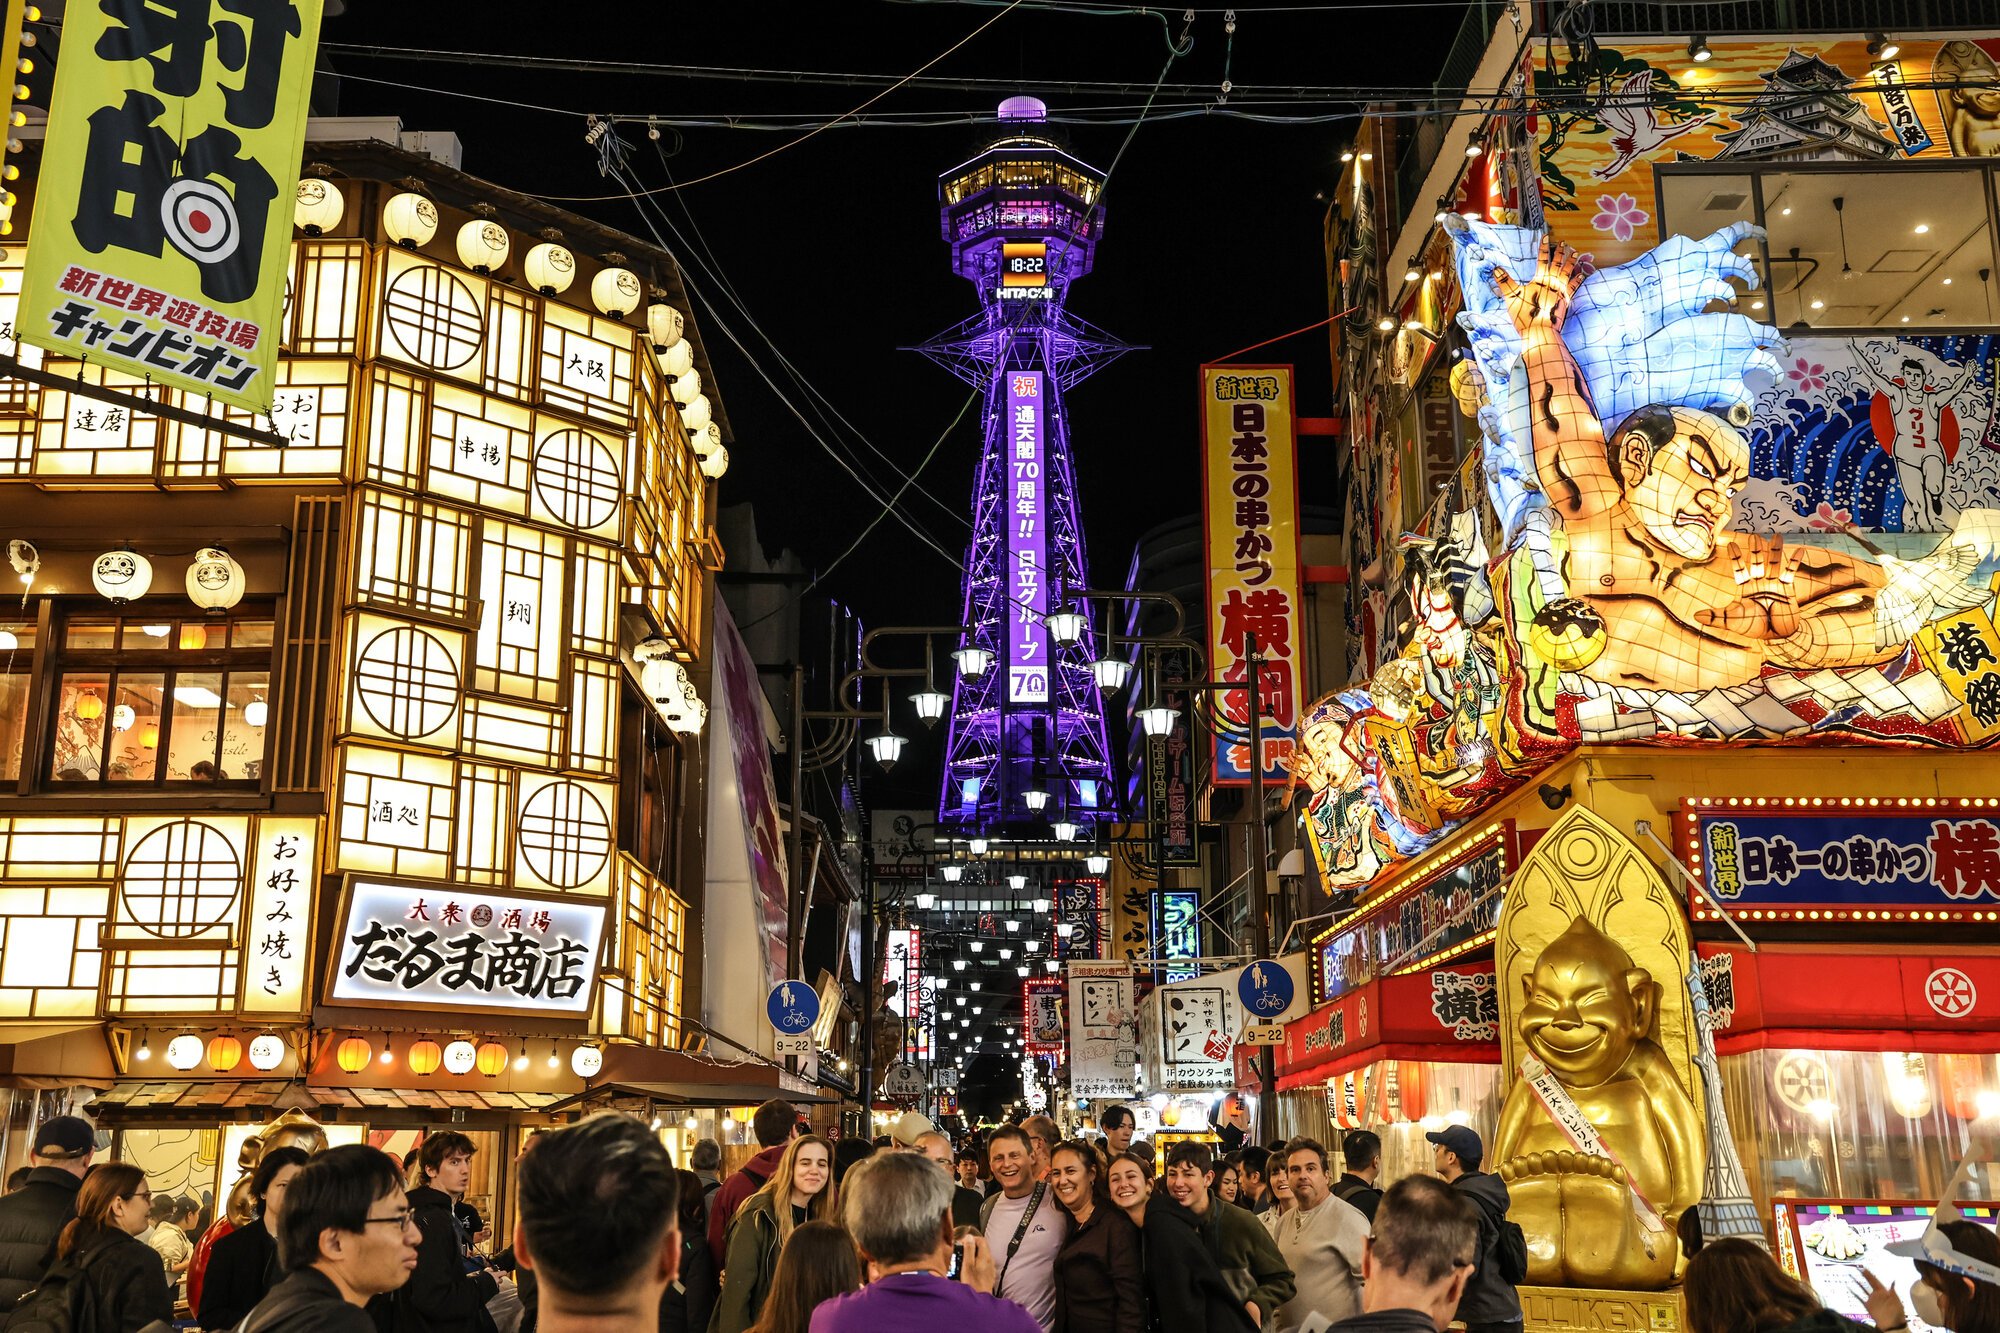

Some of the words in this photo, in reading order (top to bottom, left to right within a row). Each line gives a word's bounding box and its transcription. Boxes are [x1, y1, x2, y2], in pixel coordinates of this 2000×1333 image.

[1011, 257, 1044, 273] 18:22
[996, 287, 1053, 299] HITACHI
[59, 266, 262, 351] 新世界遊技場
[50, 301, 258, 391] チャンピオン
[566, 353, 606, 382] 大阪
[1013, 376, 1038, 397] 祝
[1215, 376, 1279, 401] 新世界
[74, 408, 127, 433] 達磨
[1908, 407, 1927, 449] グリコ
[458, 435, 502, 467] 串揚
[1231, 403, 1273, 586] 日本一の串かつ
[1017, 550, 1039, 661] 日立グループ
[1011, 672, 1046, 697] 70
[201, 730, 237, 742] Oska
[371, 799, 420, 826] 酒処
[1710, 827, 1739, 895] 新世界
[1742, 838, 1927, 882] 日本一の串かつ
[1932, 822, 2000, 896] 横
[261, 835, 299, 996] お好み焼き
[408, 899, 460, 926] 大衆
[499, 909, 552, 933] 酒場
[345, 921, 589, 1000] だるま商店
[1072, 967, 1130, 977] 元祖串カツ専門店
[1040, 996, 1057, 1031] 串カツ
[1457, 1026, 1494, 1038] よこづな
[1166, 1068, 1175, 1077] 1F
[1178, 1068, 1233, 1078] カウンター席
[1166, 1080, 1176, 1089] 2F
[1074, 1083, 1134, 1095] 宴会予約受付中
